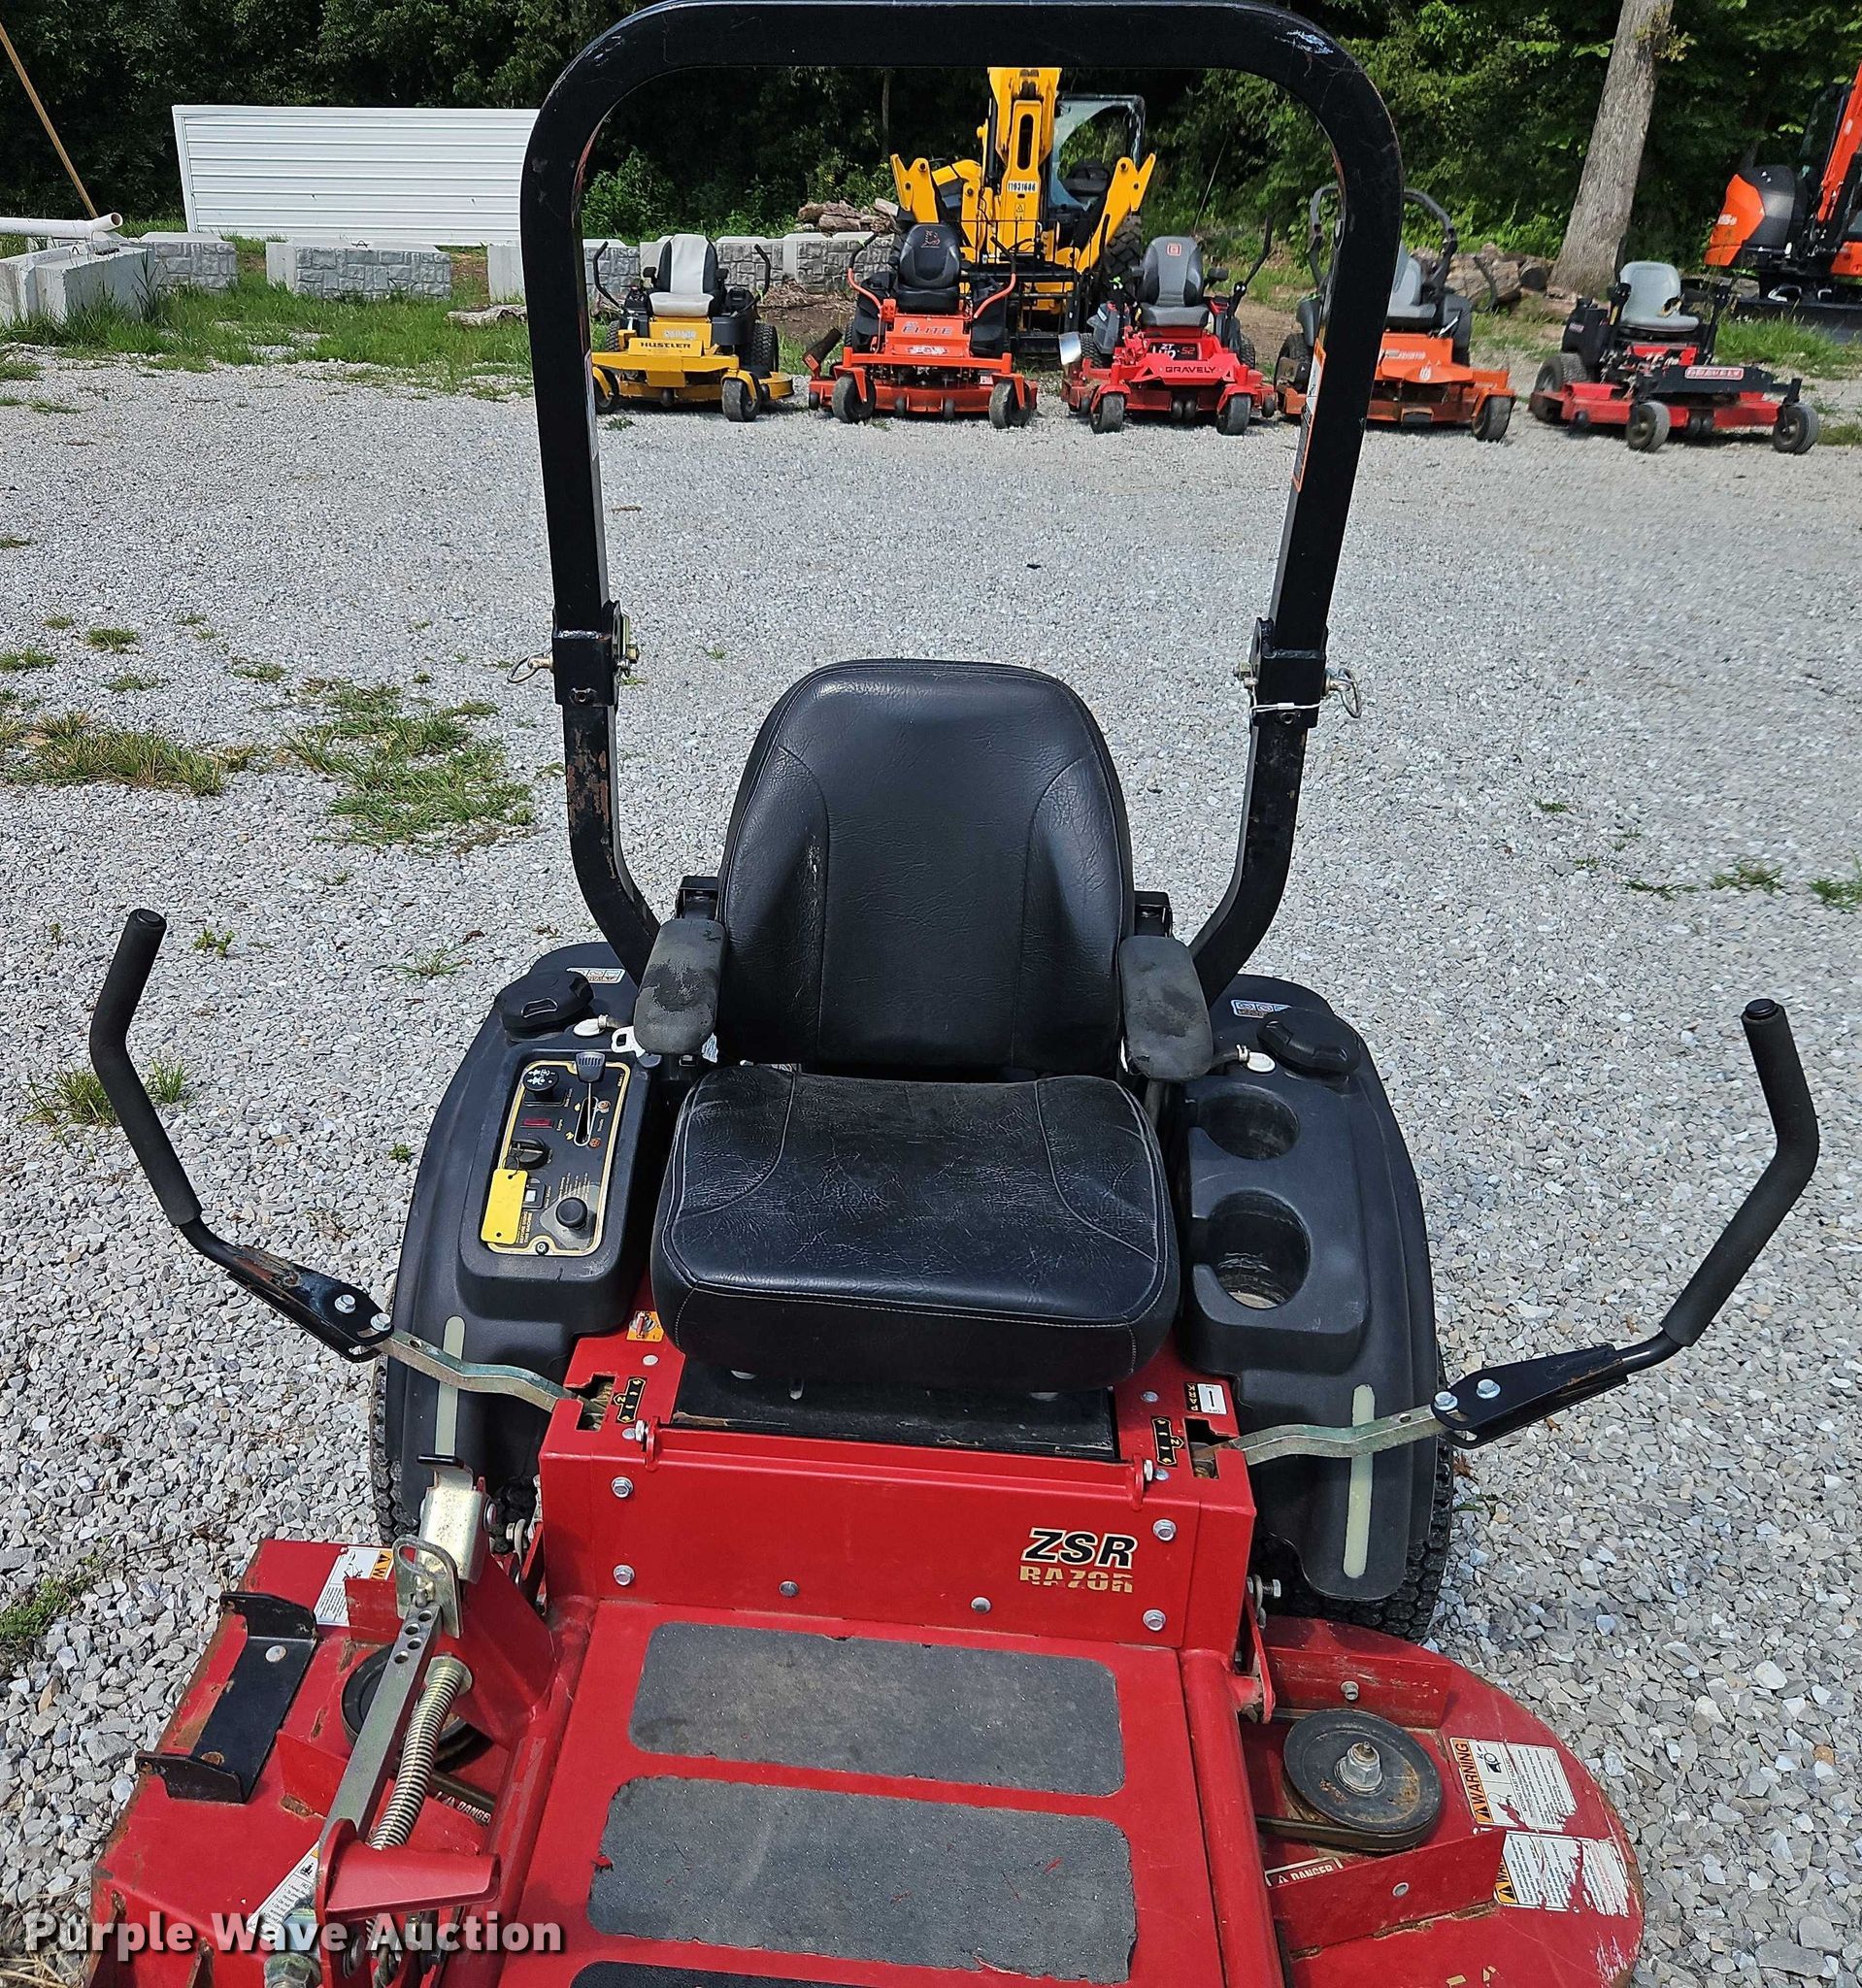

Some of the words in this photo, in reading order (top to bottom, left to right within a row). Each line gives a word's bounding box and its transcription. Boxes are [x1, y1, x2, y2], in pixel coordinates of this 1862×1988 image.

[640, 341, 691, 349] HUSTLER
[1020, 1527, 1138, 1570] ZSR
[1019, 1565, 1134, 1594] RAZOR
[1455, 1743, 1485, 1805] WARNING
